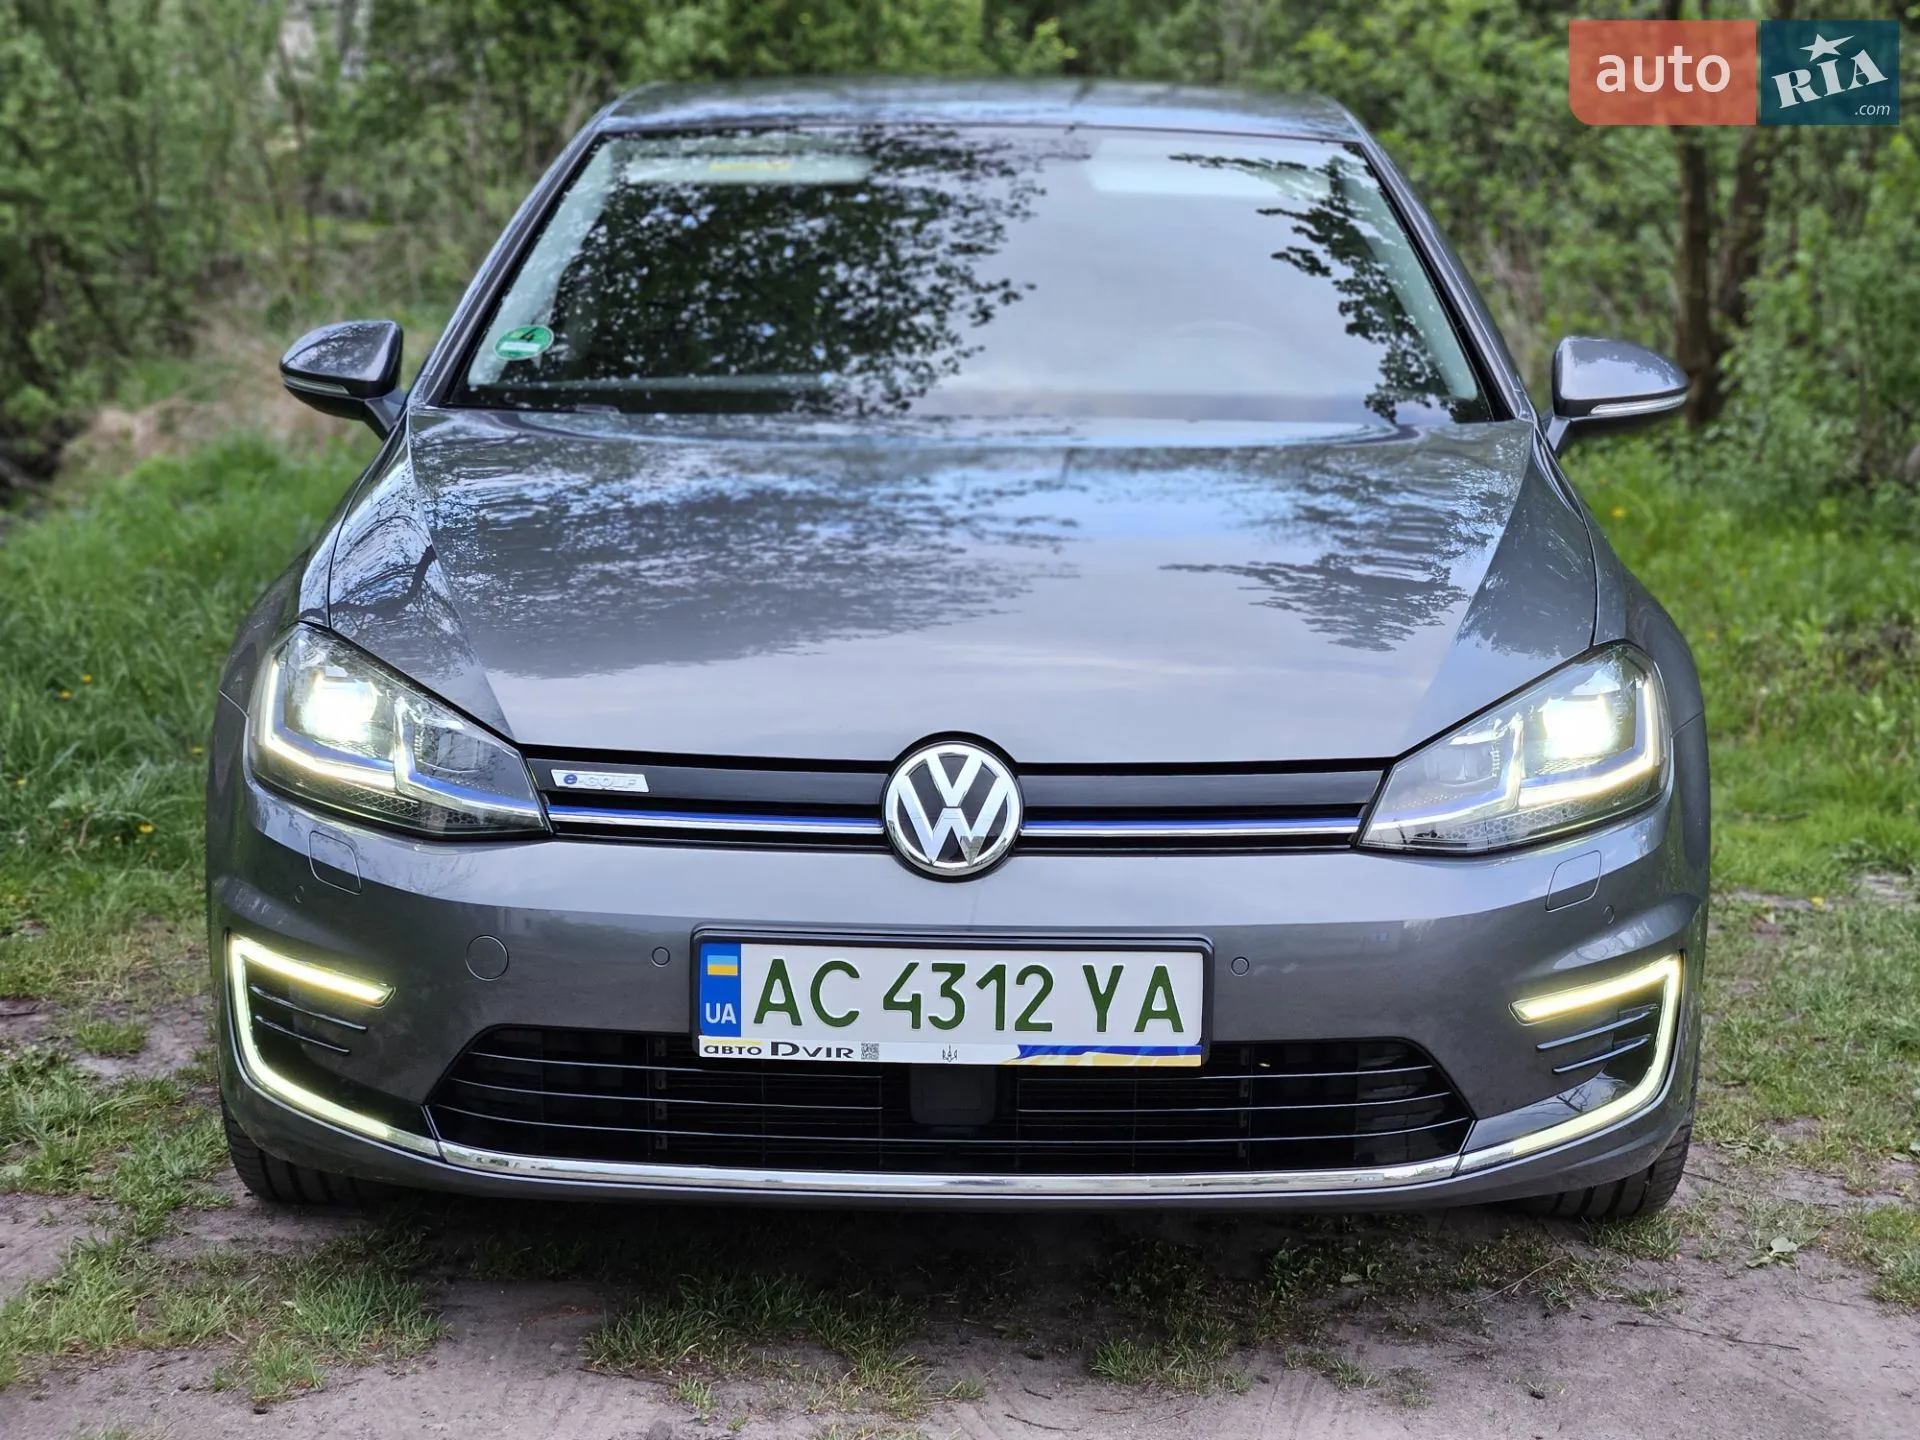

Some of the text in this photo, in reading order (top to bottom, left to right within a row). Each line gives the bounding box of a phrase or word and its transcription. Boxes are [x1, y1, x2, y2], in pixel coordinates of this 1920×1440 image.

[705, 1003, 737, 1025] UA
[753, 958, 1185, 1033] AC 4312 YA
